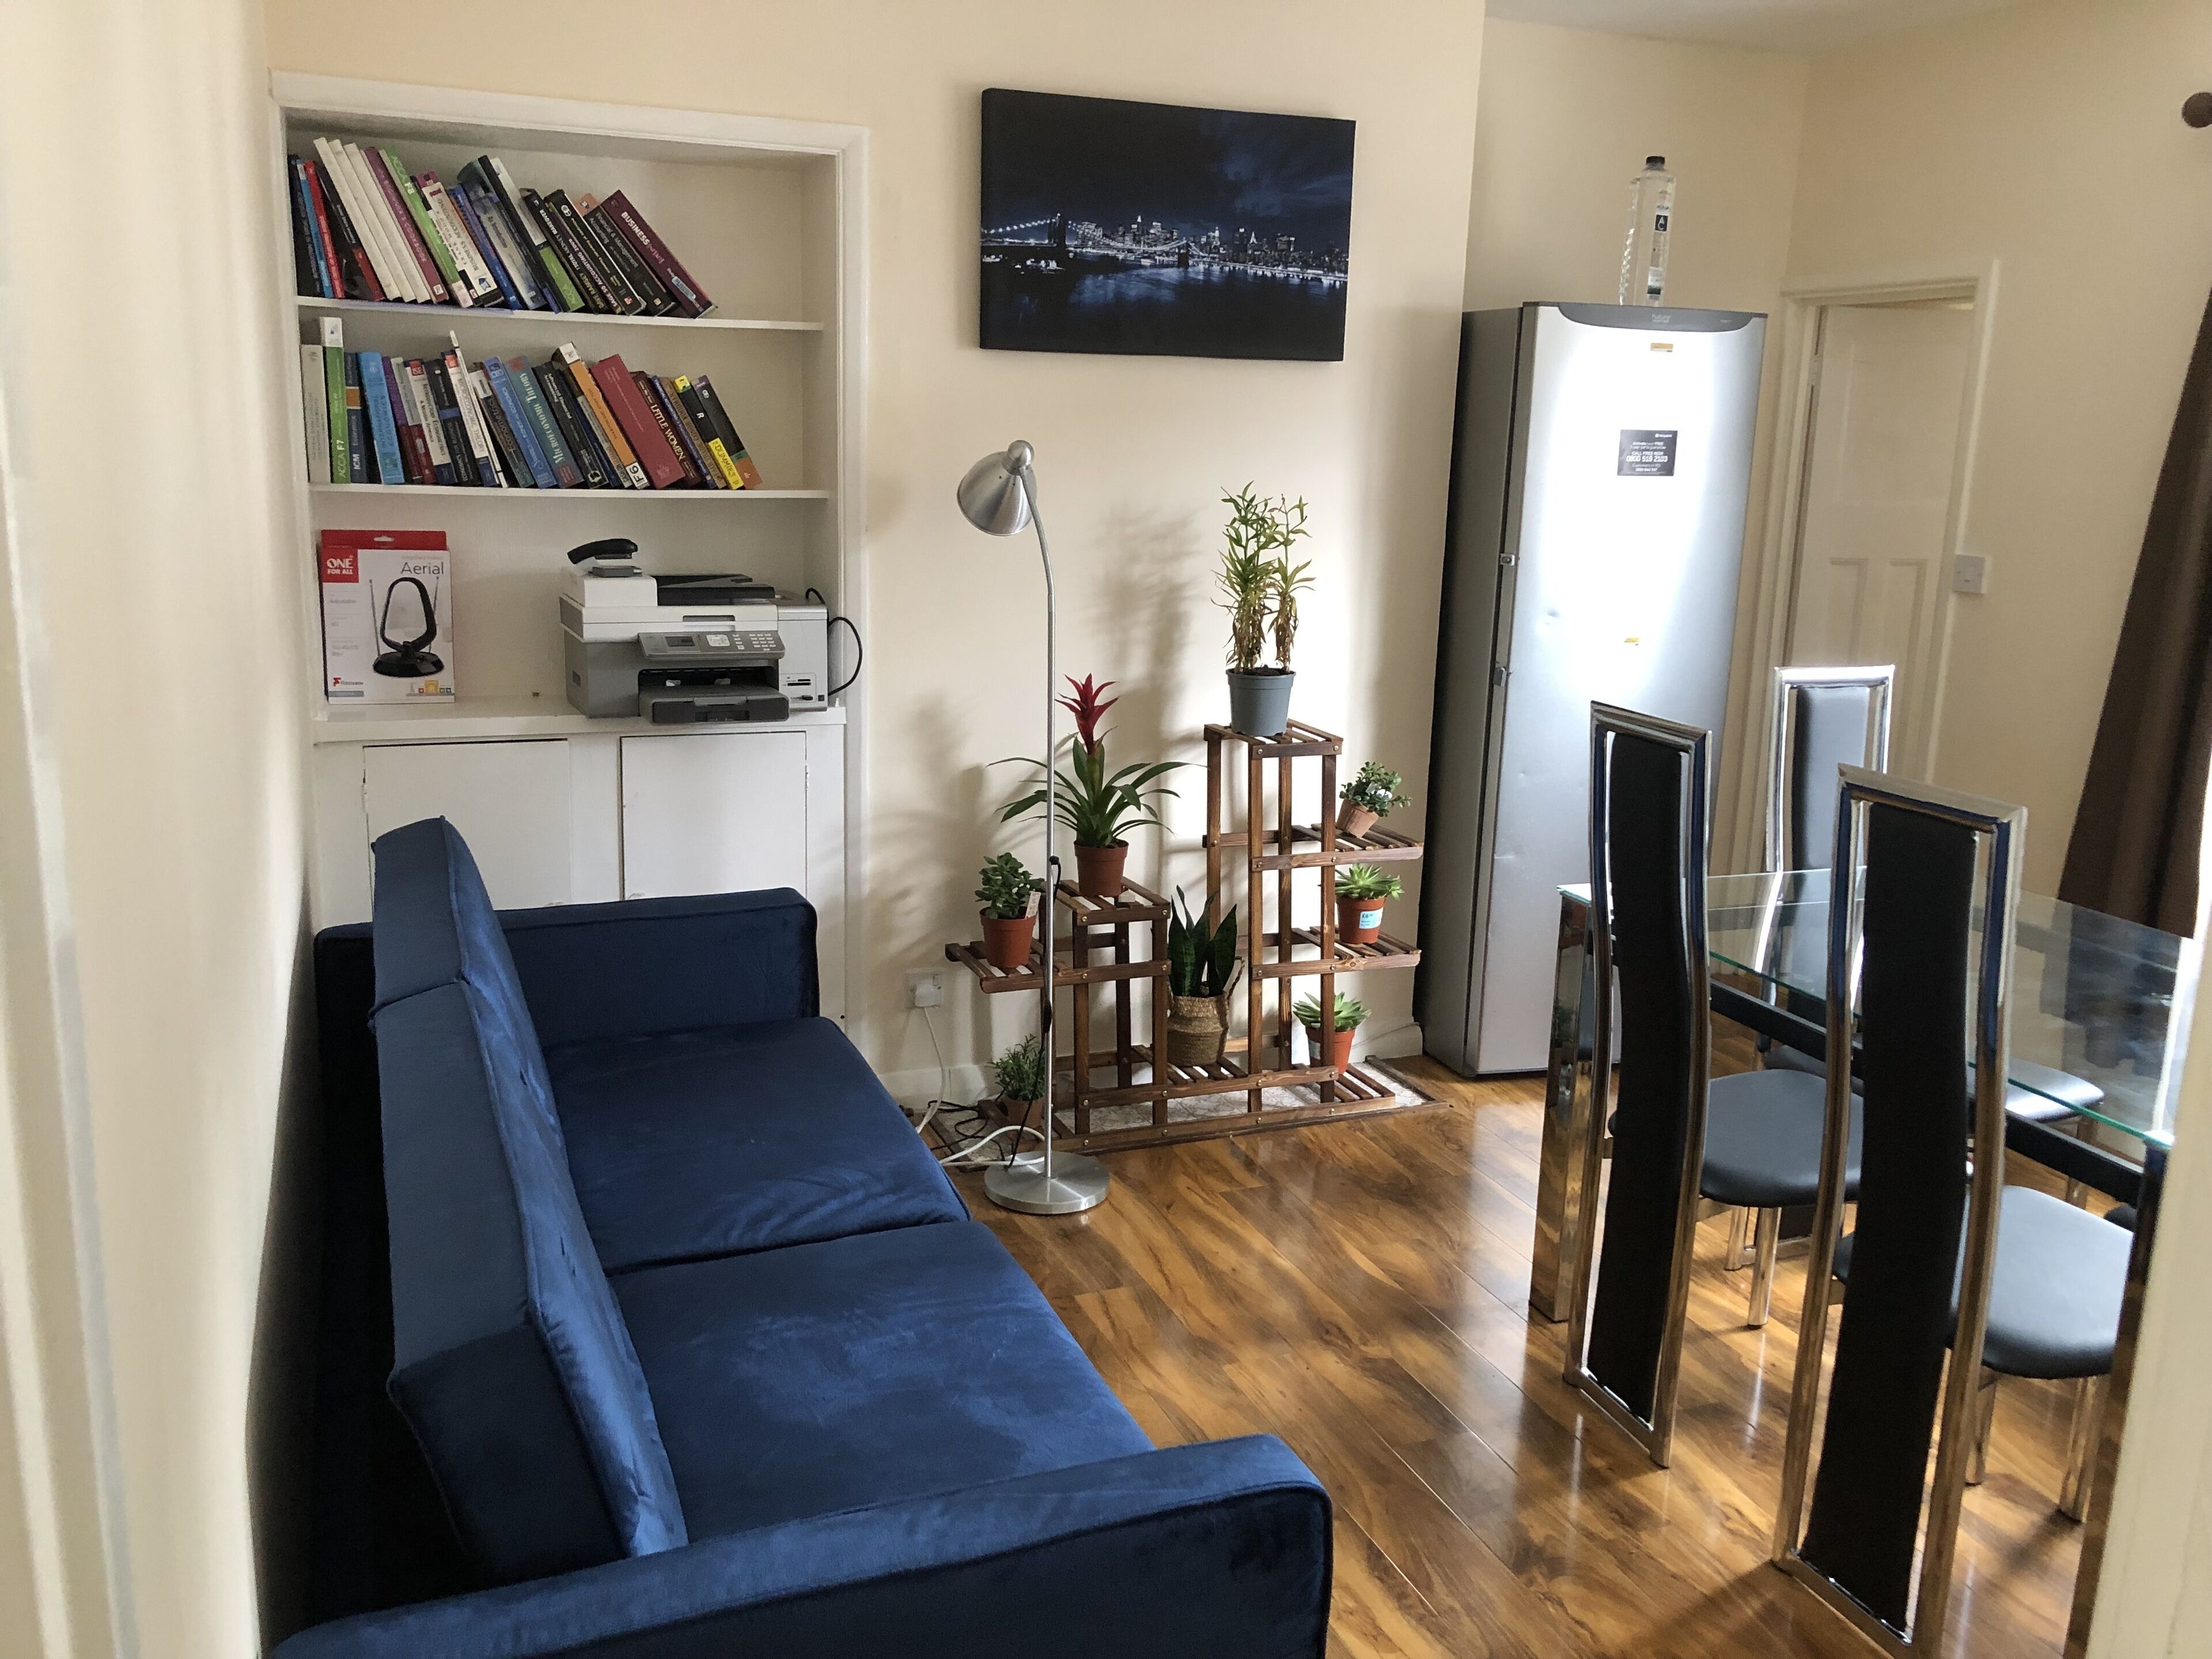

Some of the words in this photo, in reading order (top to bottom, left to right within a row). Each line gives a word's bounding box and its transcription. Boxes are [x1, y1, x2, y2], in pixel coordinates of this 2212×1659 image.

[389, 154, 408, 181] ACCA
[435, 197, 463, 240] ACCOUNTING
[539, 208, 558, 235] MAKEOVER
[586, 216, 611, 245] Accounting
[620, 210, 650, 246] BUSINESS
[403, 221, 427, 263] COOKBOOK
[555, 233, 571, 254] MONEY
[594, 211, 613, 234] Financial
[612, 236, 639, 269] Management
[459, 240, 480, 271] BUSINESS
[567, 252, 579, 268] TOTAL
[576, 251, 603, 286] ACCOUNTING
[578, 271, 596, 295] RAMSEY
[600, 284, 608, 293] 50
[593, 294, 605, 309] DAVE
[605, 291, 618, 308] SAGE
[543, 373, 559, 403] Accounting
[547, 372, 561, 397] Advanced
[558, 395, 573, 419] Financial
[653, 378, 666, 398] FINANCIAL
[422, 382, 437, 419] INTRODUCTORY
[431, 419, 447, 456] ECONOMETRICS
[457, 377, 478, 430] MICROECONOMIC
[472, 428, 485, 453] THEORY
[668, 391, 688, 421] WOODMAN
[696, 410, 705, 419] R
[372, 393, 387, 448] INTERNATIONAL
[379, 394, 395, 448] ECONOMICS
[486, 396, 516, 453] Econometrics
[649, 403, 669, 430] LITTLE
[662, 427, 687, 462] WOMEN
[683, 420, 700, 442] CONOR
[336, 438, 344, 450] F7
[696, 442, 711, 463] TRADE
[336, 452, 347, 478] ACCA
[352, 453, 361, 470] ICM
[455, 453, 468, 482] ECONOMICS
[615, 463, 623, 472] ON
[628, 464, 644, 483] F6
[714, 444, 736, 478] DUMMIES
[618, 469, 629, 483] CASH
[327, 558, 354, 568] ONE
[401, 561, 444, 574] Aerial
